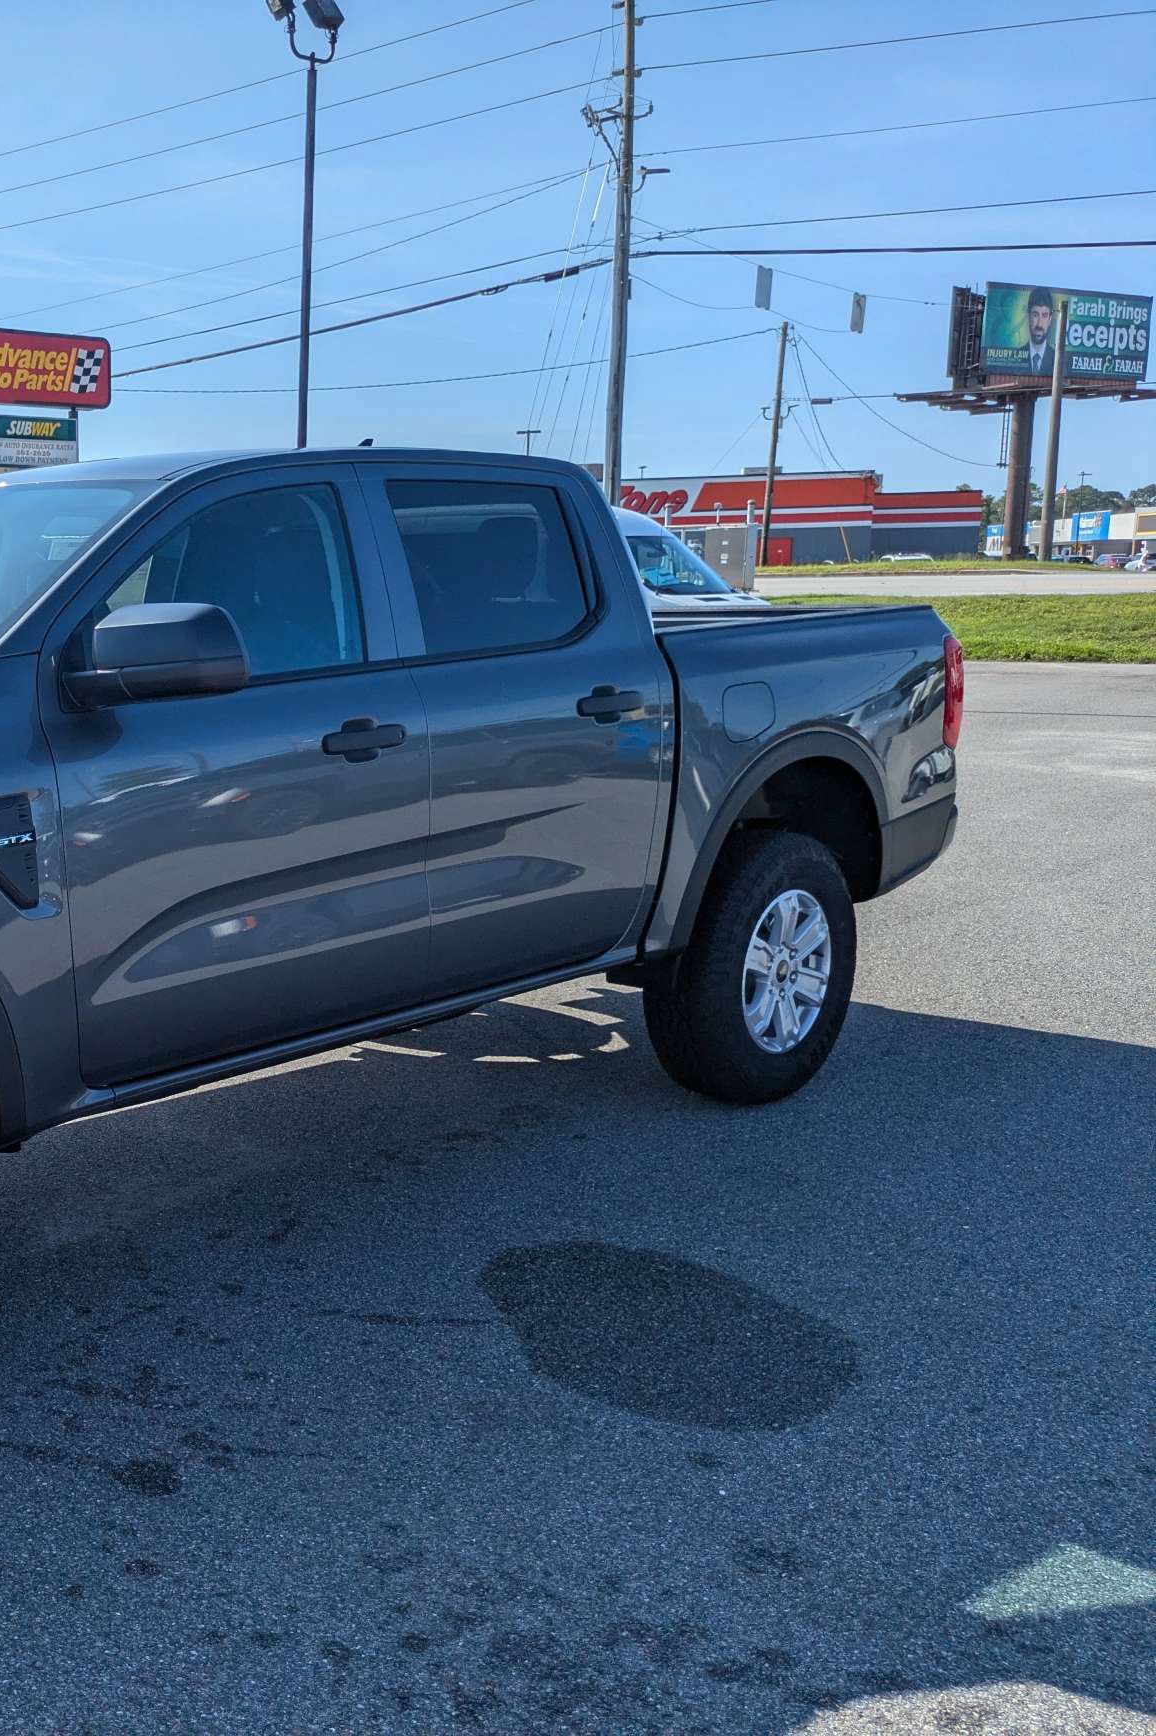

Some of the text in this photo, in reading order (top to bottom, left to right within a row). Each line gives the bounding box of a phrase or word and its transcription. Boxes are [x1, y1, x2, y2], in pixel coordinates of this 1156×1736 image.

[1069, 297, 1148, 325] Farah Brings
[1065, 318, 1147, 355] eceipts
[987, 349, 1012, 358] INJURY
[1014, 351, 1029, 360] LAW
[1072, 355, 1144, 374] FARAH & FARAH
[13, 370, 64, 391] Parts
[6, 420, 58, 437] SUBWAY
[15, 456, 36, 464] DOWN
[37, 457, 69, 465] PAYMENT
